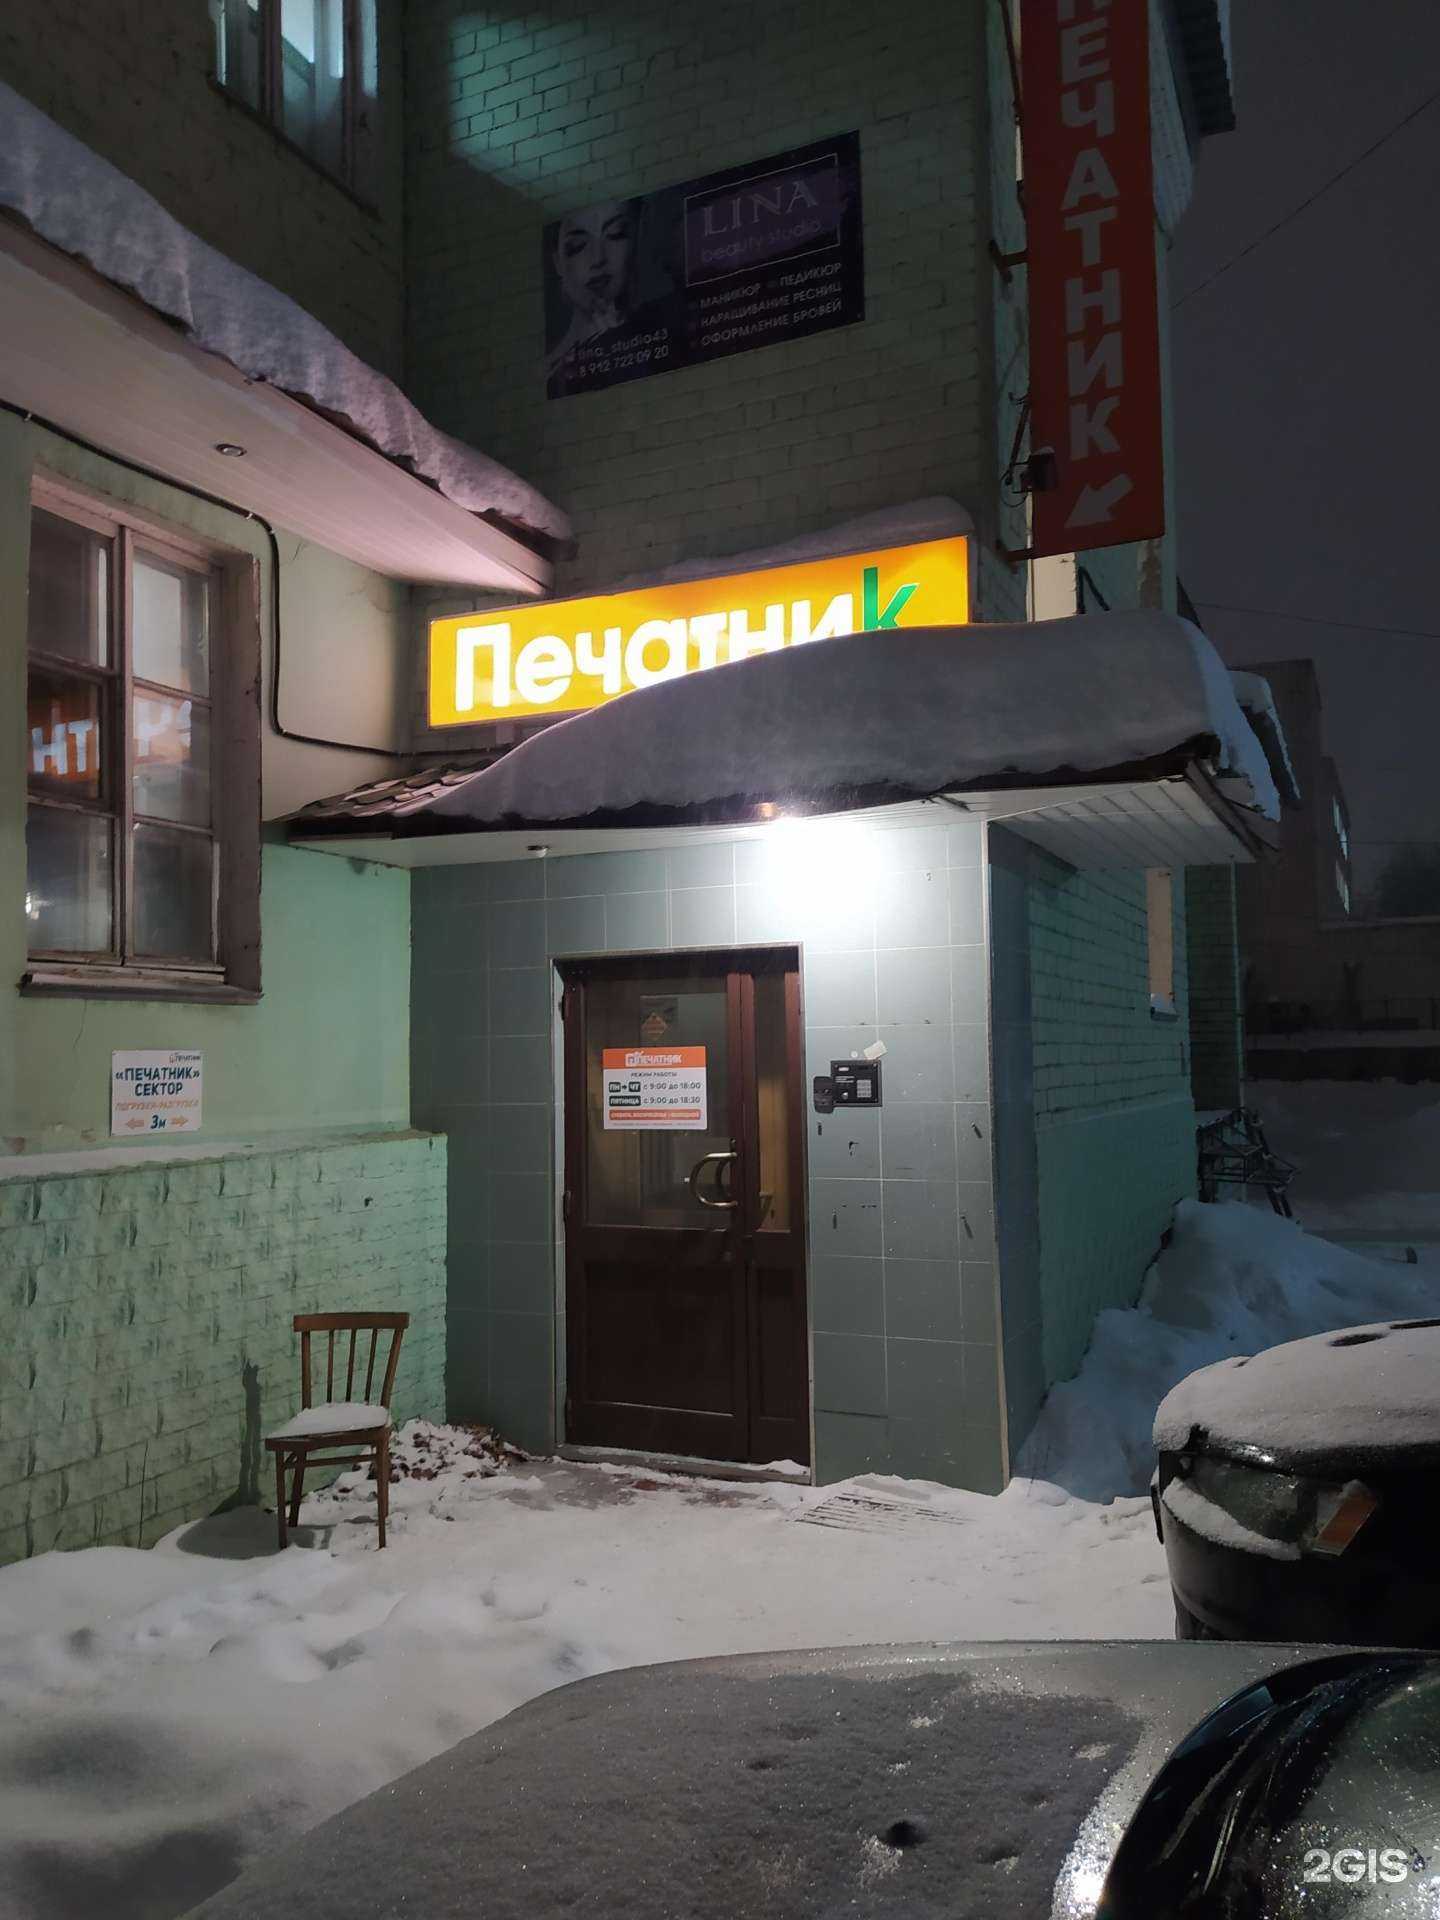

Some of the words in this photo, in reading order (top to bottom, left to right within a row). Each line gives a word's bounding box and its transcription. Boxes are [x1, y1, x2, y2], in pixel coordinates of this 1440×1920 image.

[704, 179, 819, 237] LINA
[700, 283, 761, 308] МАНИКЮР
[779, 262, 842, 287] ПЕДИКЮР
[701, 294, 790, 328] НАРАЩИВАНИЕ
[792, 281, 843, 304] РЕСНИЦ
[701, 313, 789, 346] ОФОРМЛЕНИЕ
[793, 297, 842, 323] БРОВЕЙ
[654, 344, 669, 360] 20
[115, 1066, 200, 1081] «ПЕЧАТНИК»
[134, 1082, 183, 1097] СЕКТОР
